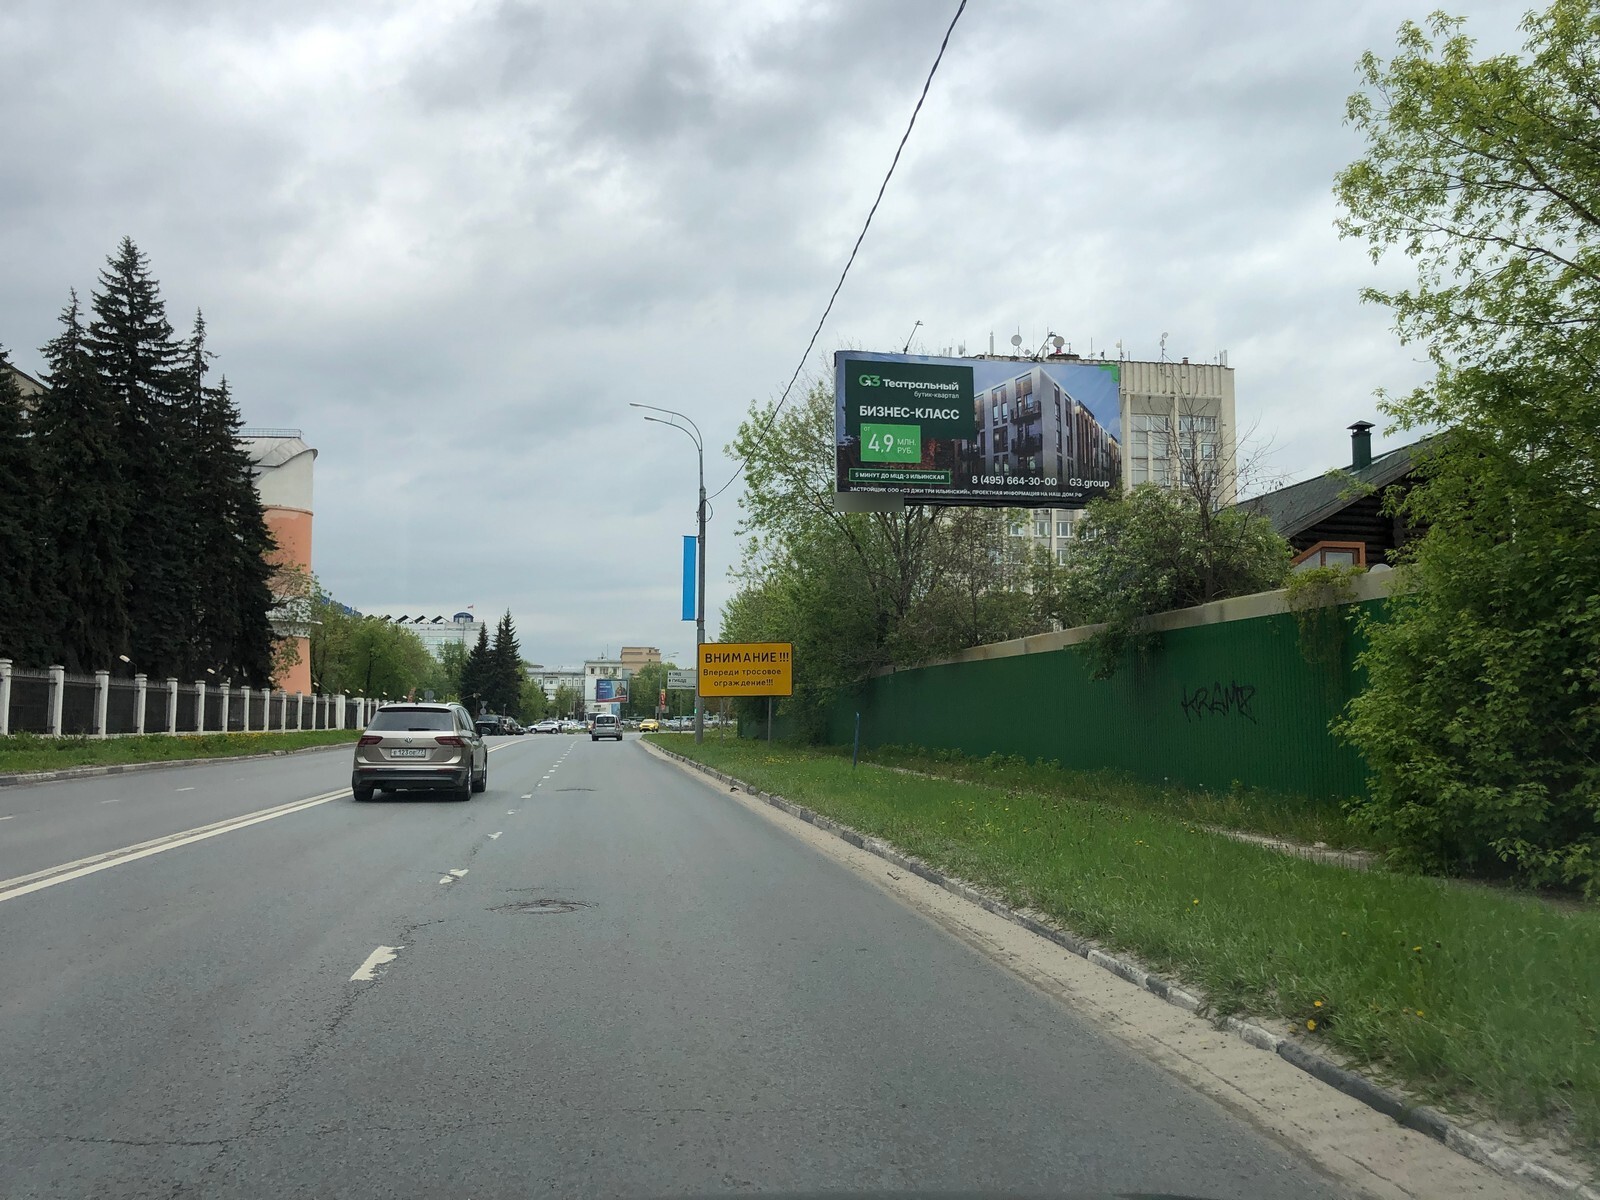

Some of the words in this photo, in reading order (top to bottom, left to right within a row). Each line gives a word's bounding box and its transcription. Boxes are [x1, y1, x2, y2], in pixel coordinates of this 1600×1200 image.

[883, 378, 959, 391] Театральный
[914, 391, 960, 399] бутик-квартал
[859, 405, 960, 420] БИЗНЕС-КЛАСС
[868, 433, 894, 453] 4,9
[897, 438, 916, 446] МЛН.
[897, 447, 914, 455] РУБ.
[971, 475, 978, 484] 8
[980, 475, 1005, 486] (495)
[1006, 476, 1057, 486] 664-30-00
[1069, 478, 1110, 488] G3.group
[703, 668, 739, 677] Впереди
[713, 678, 774, 688] ограждение!!!
